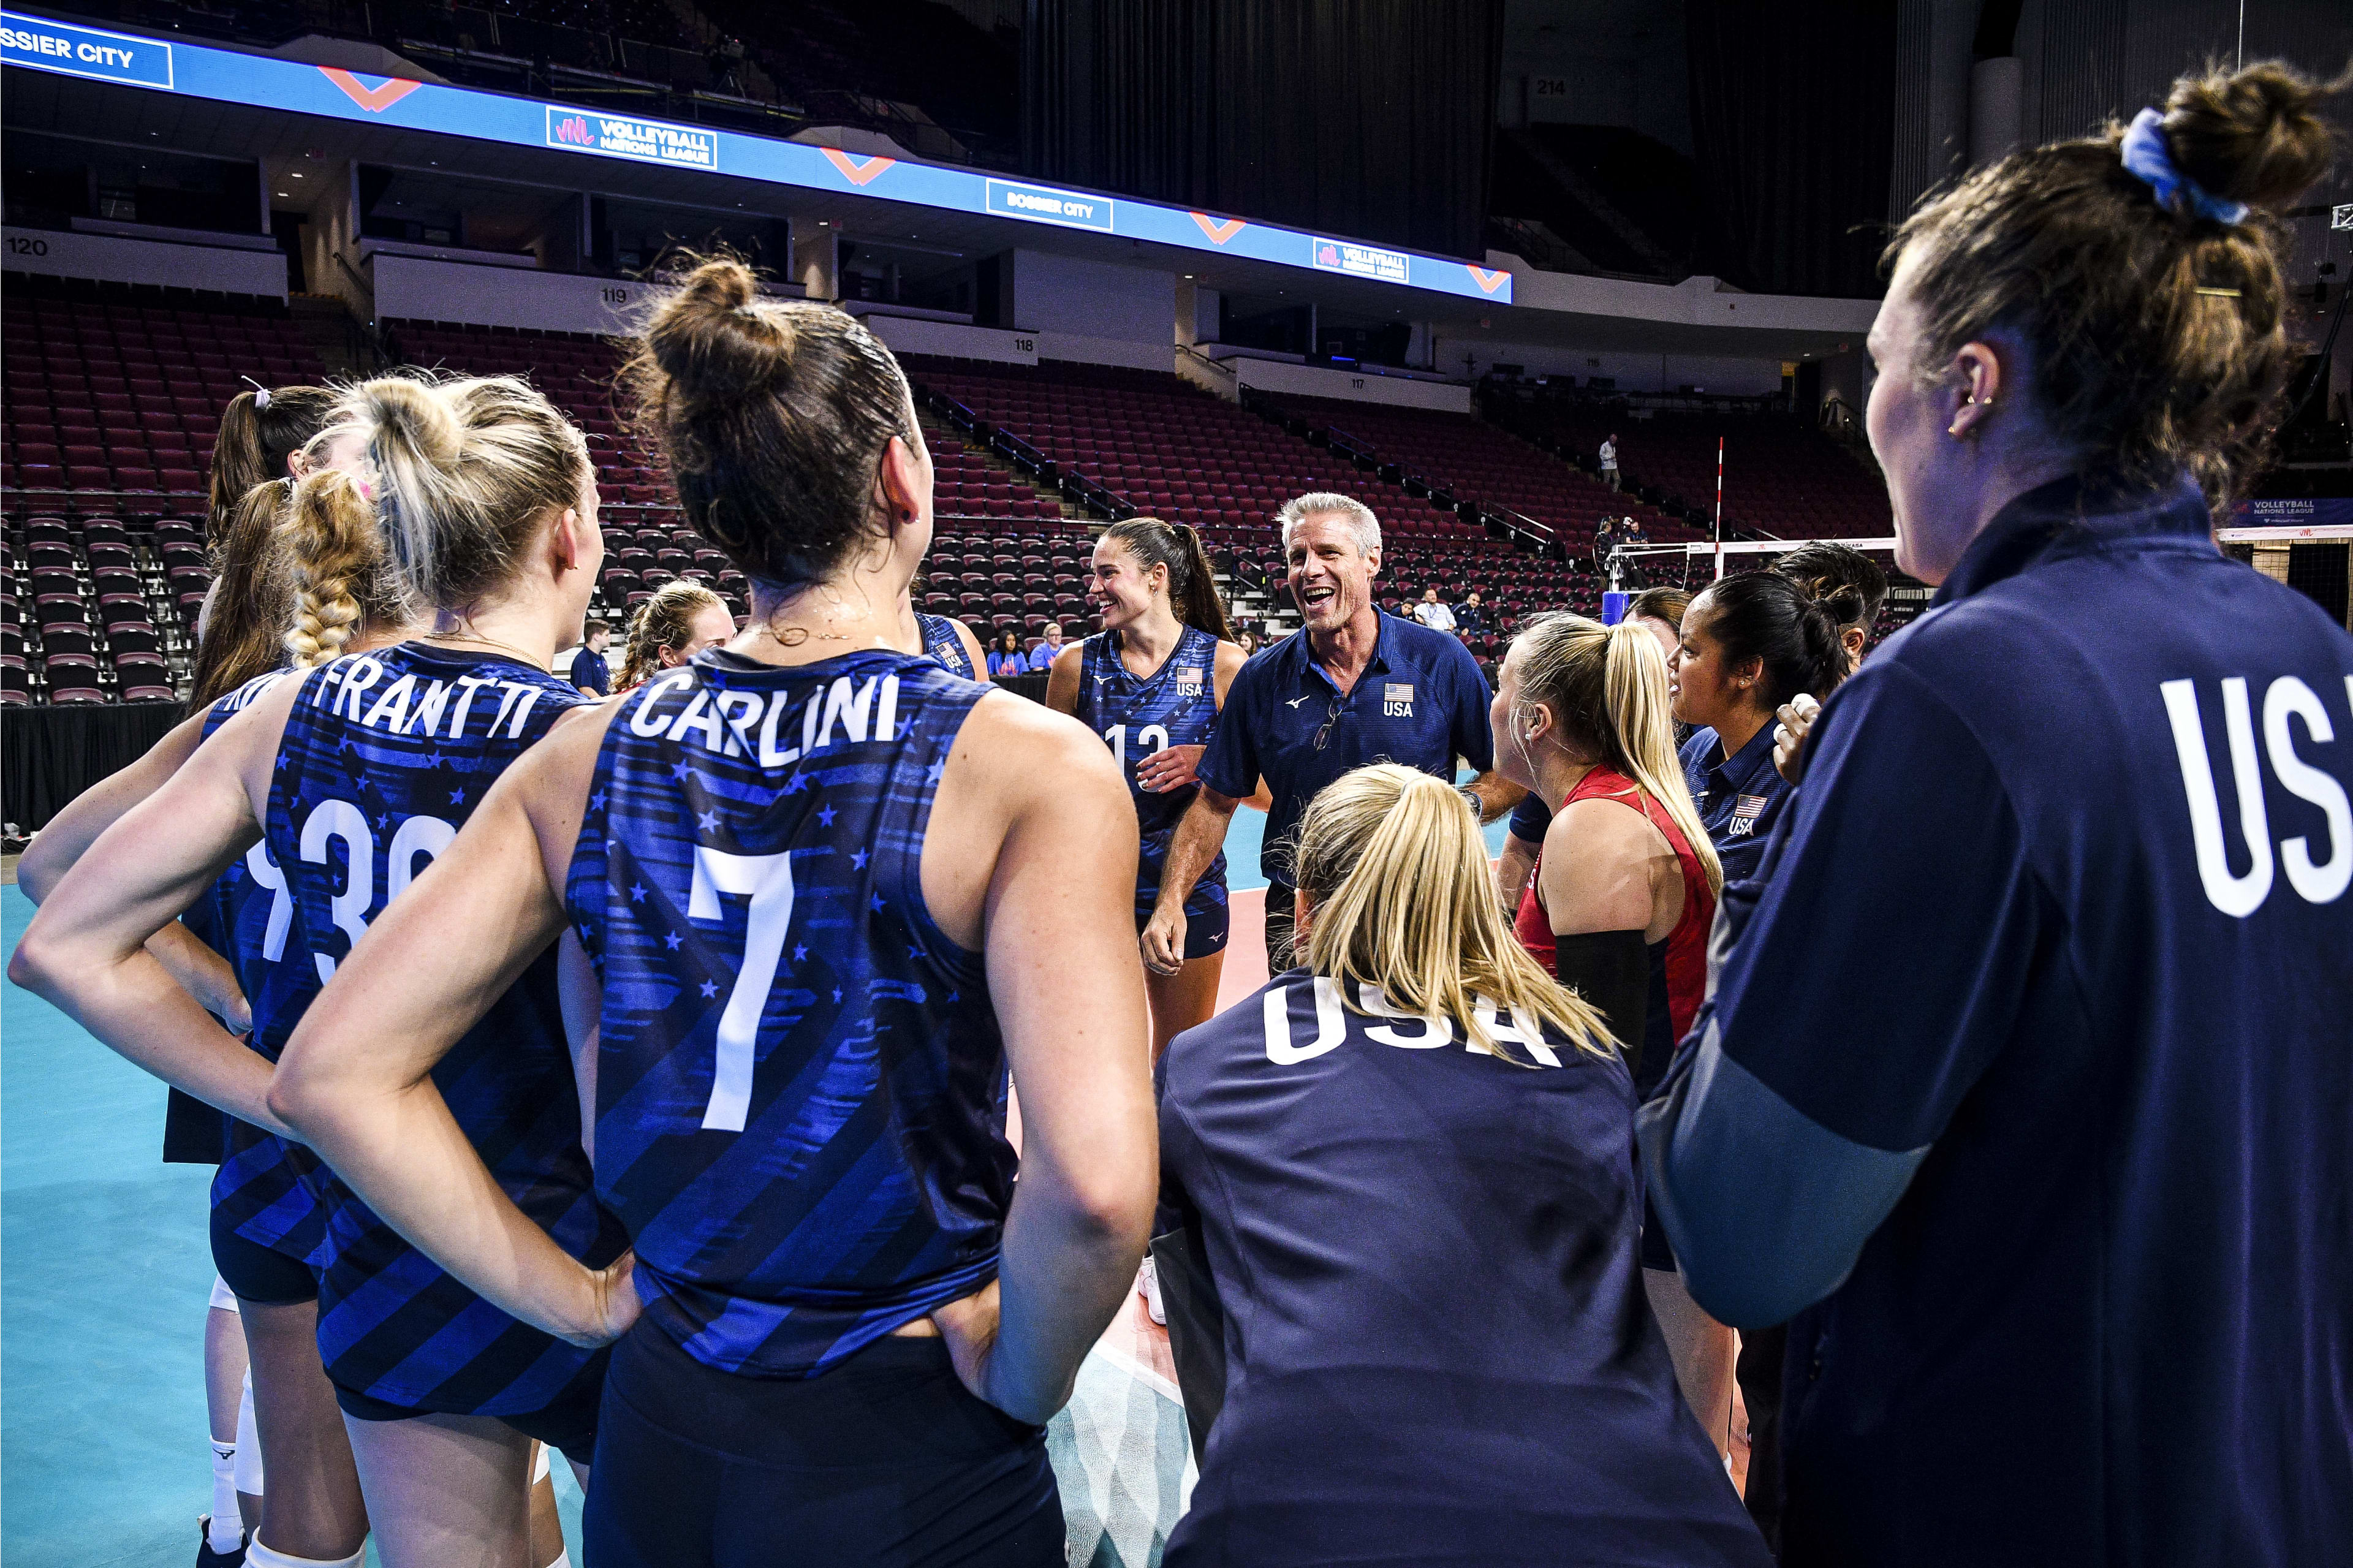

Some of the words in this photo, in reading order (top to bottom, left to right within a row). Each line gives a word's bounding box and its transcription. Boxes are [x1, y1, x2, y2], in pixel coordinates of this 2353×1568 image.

[77, 43, 134, 69] CITY
[1537, 80, 1565, 95] 214
[599, 119, 710, 152] VOLLEYBALL
[600, 137, 657, 156] NATIONS
[1063, 202, 1094, 219] CITY
[7, 238, 47, 256] 120
[602, 288, 626, 303] 119
[1015, 339, 1033, 352] 118
[2254, 500, 2314, 509] VOLLEYBALL
[944, 654, 964, 669] USA
[1176, 683, 1202, 697] USA
[1384, 701, 1413, 718] USA
[629, 673, 900, 768] CARLINI
[2159, 674, 2353, 919] US
[1729, 816, 1754, 836] USA
[688, 844, 794, 1132] 7
[1263, 977, 1563, 1068] USA
